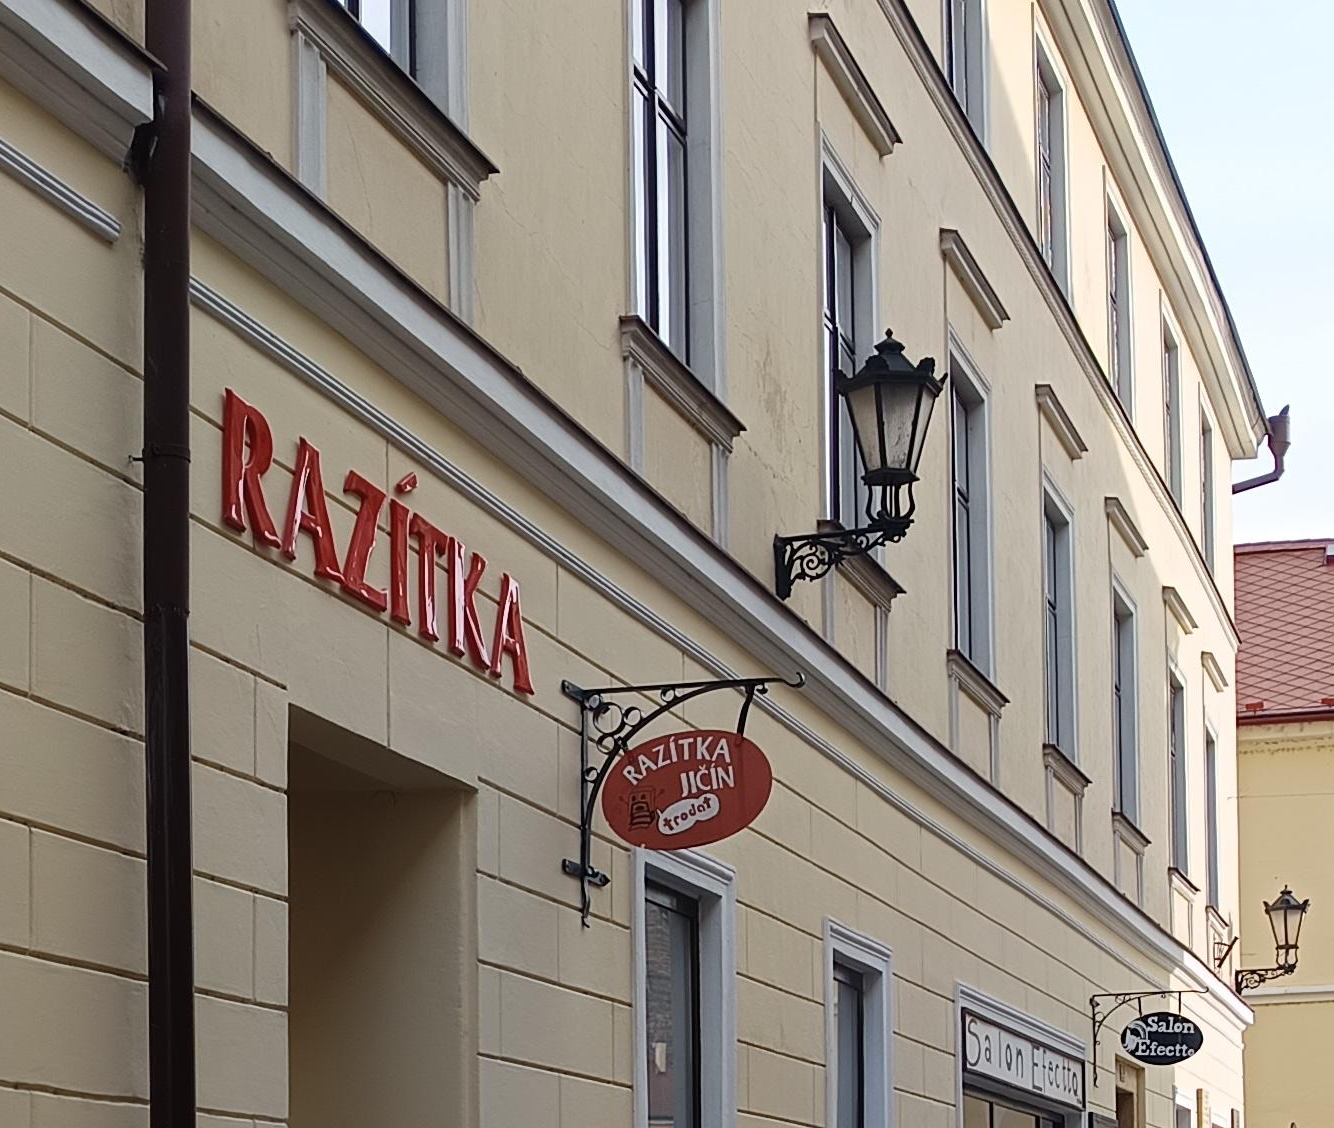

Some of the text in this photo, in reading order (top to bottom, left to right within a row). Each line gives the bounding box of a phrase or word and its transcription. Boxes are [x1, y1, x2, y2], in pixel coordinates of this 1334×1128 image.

[221, 386, 535, 695] RAZÍTKA
[622, 735, 731, 786] RAZÍTKA
[680, 763, 735, 798] JIČÍN
[663, 796, 712, 832] trodat
[1147, 1016, 1195, 1034] Salon
[966, 1018, 1024, 1079] Salon
[1134, 1039, 1195, 1057] Efectto
